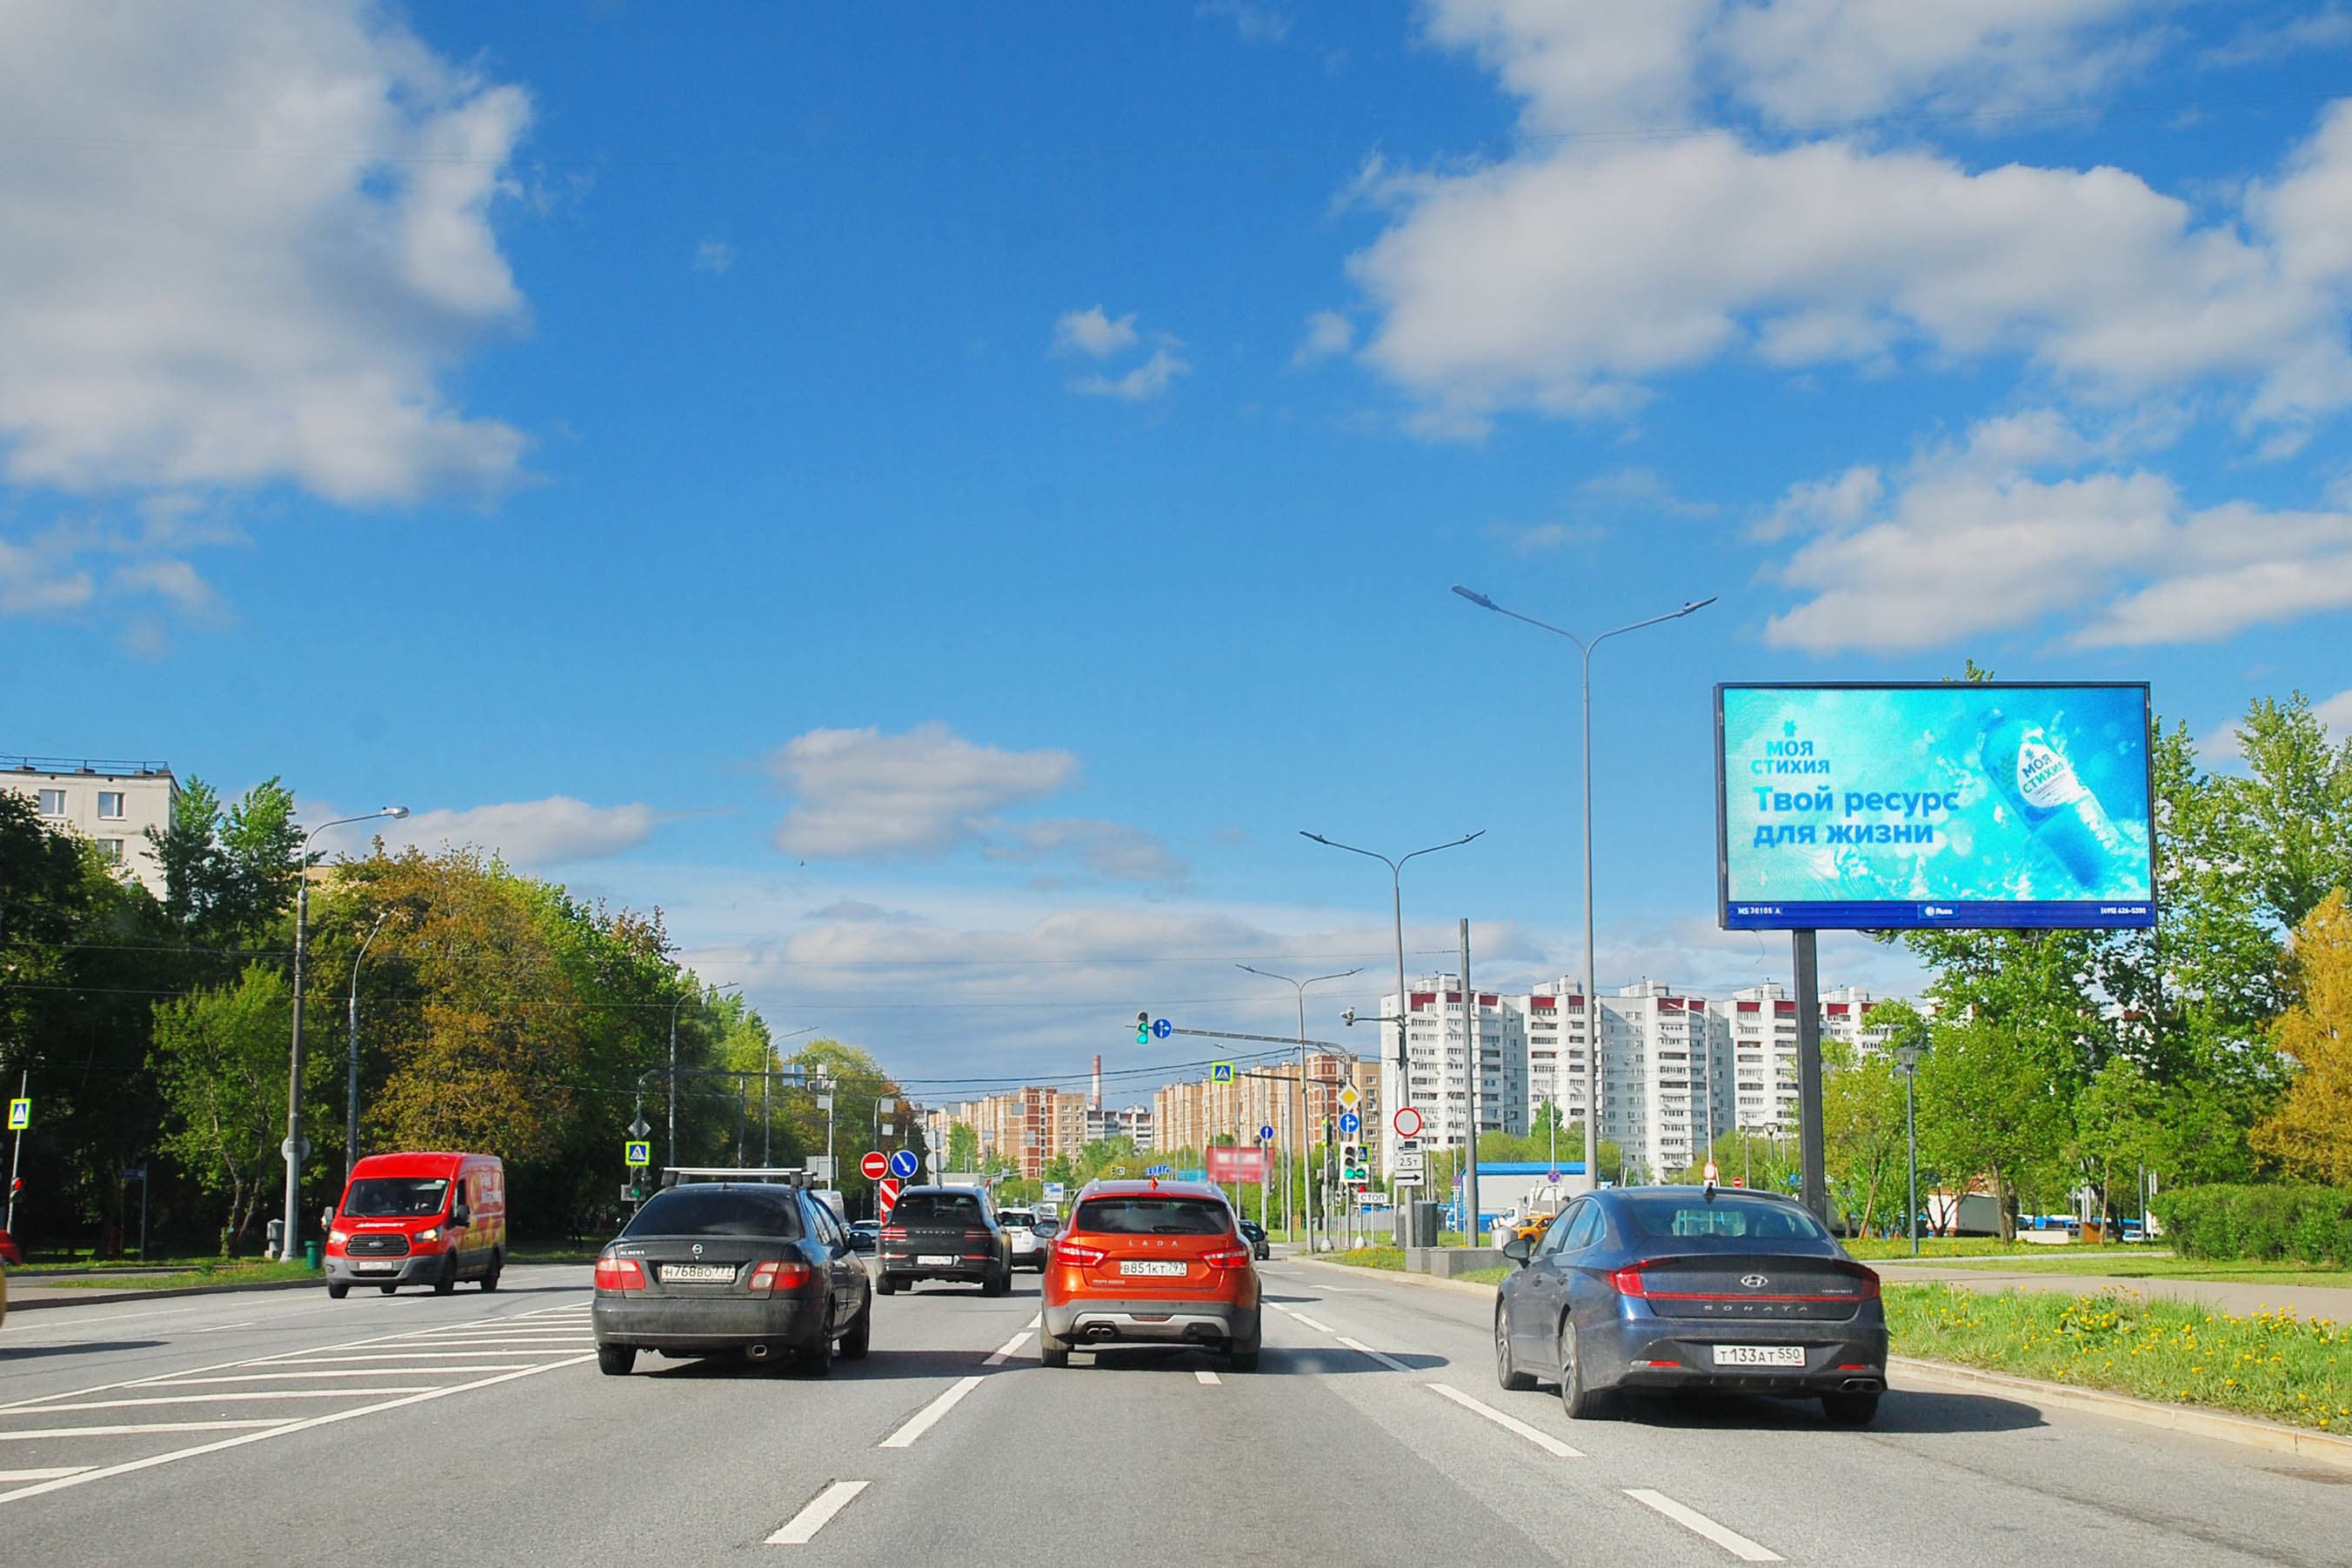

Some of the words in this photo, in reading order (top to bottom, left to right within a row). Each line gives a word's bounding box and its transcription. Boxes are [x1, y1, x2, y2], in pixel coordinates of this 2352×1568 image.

[1767, 740, 1814, 757] МОЯ
[1750, 759, 1830, 774] СТИХИЯ
[2021, 754, 2053, 778] МОЯ
[1753, 785, 1834, 811] Твой
[1845, 791, 1960, 817] ресурс
[1754, 824, 1816, 848] для
[1827, 824, 1934, 844] жизни
